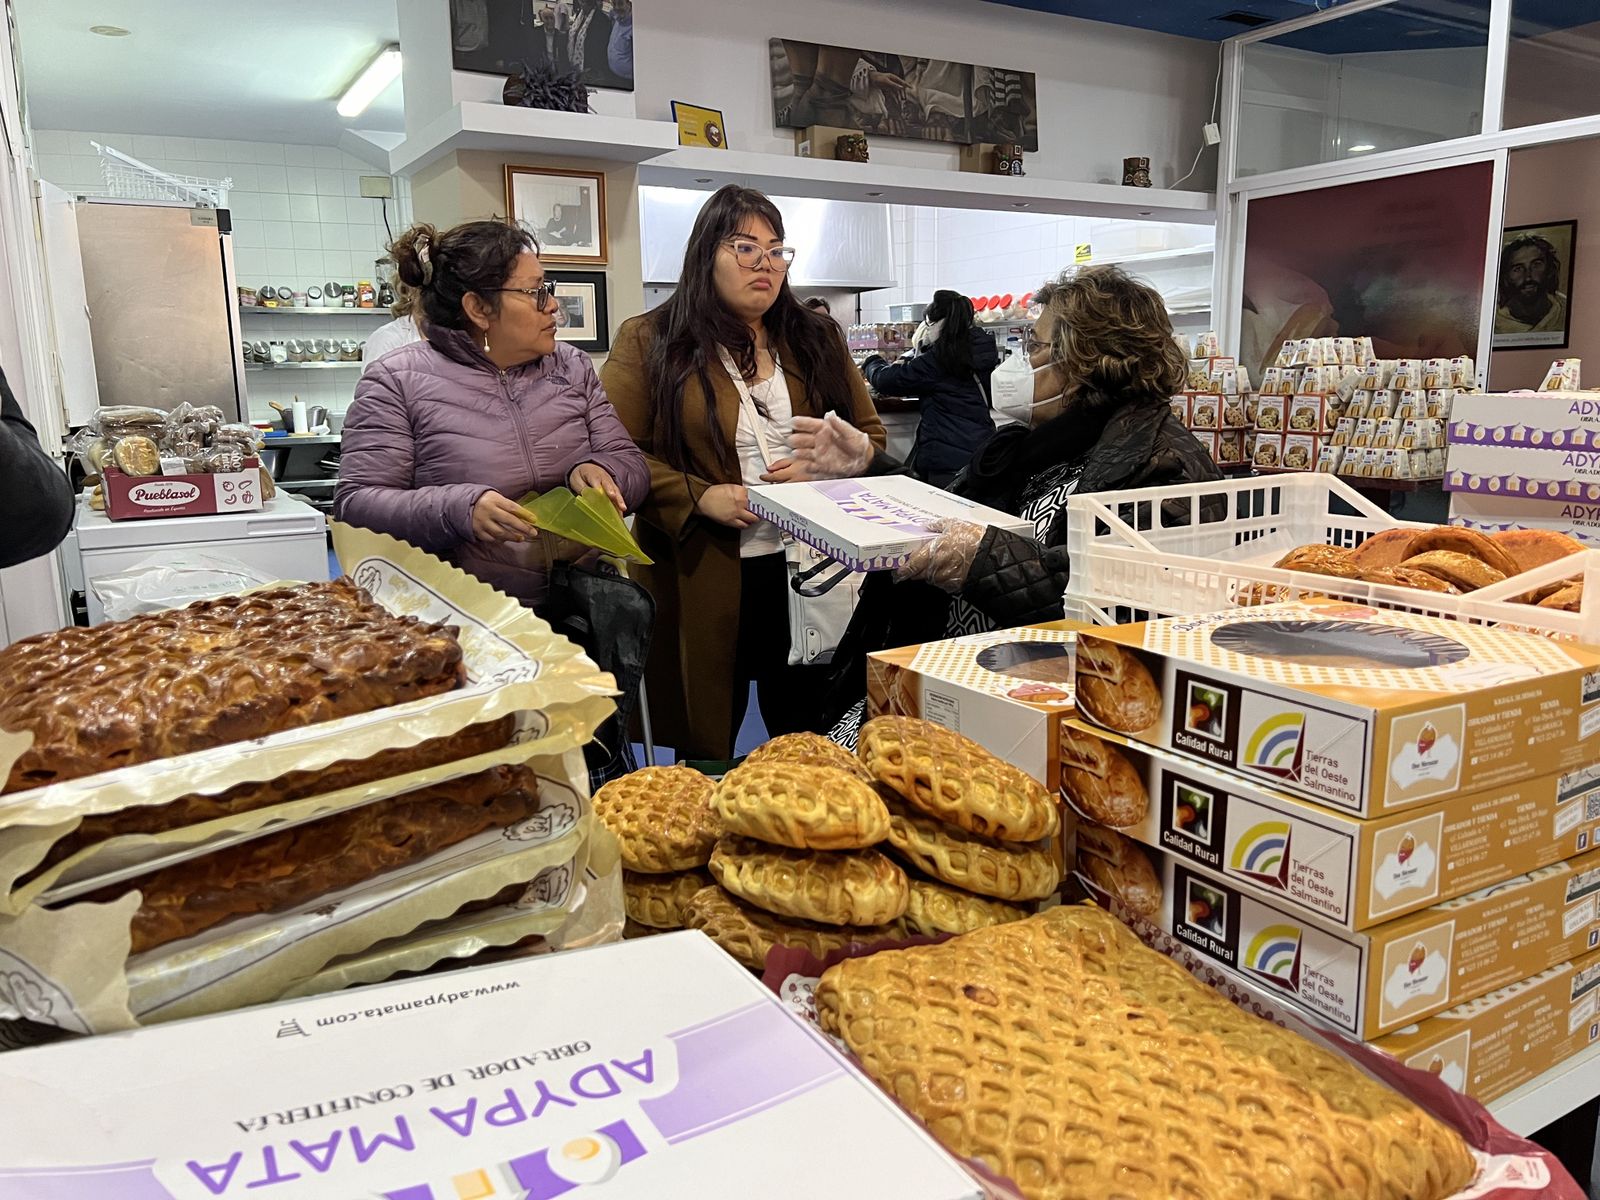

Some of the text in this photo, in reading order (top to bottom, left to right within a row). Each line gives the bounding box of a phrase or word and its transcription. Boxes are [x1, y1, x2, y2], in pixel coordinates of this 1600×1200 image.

[1562, 453, 1600, 469] ADY
[134, 487, 196, 502] Pueblasol
[1176, 732, 1233, 761] Calidad Rural
[1305, 750, 1339, 768] Tierras
[1304, 763, 1349, 785] del Oeste
[1303, 777, 1356, 802] Salmantino
[1164, 830, 1219, 865] Calidad Rural
[1292, 859, 1325, 880] Tierras
[1291, 872, 1335, 898] del Oeste
[1290, 886, 1342, 915] Salmantino
[1176, 924, 1234, 961] Calidad Rural
[1302, 963, 1335, 987] Tierras
[316, 979, 520, 1027] www.adypamata.com
[1302, 977, 1344, 1006] del Oeste
[1301, 990, 1351, 1023] Salmantino
[465, 1040, 592, 1081] OBRADOR
[422, 1072, 455, 1092] DE
[185, 1049, 655, 1195] ADYPA MATA
